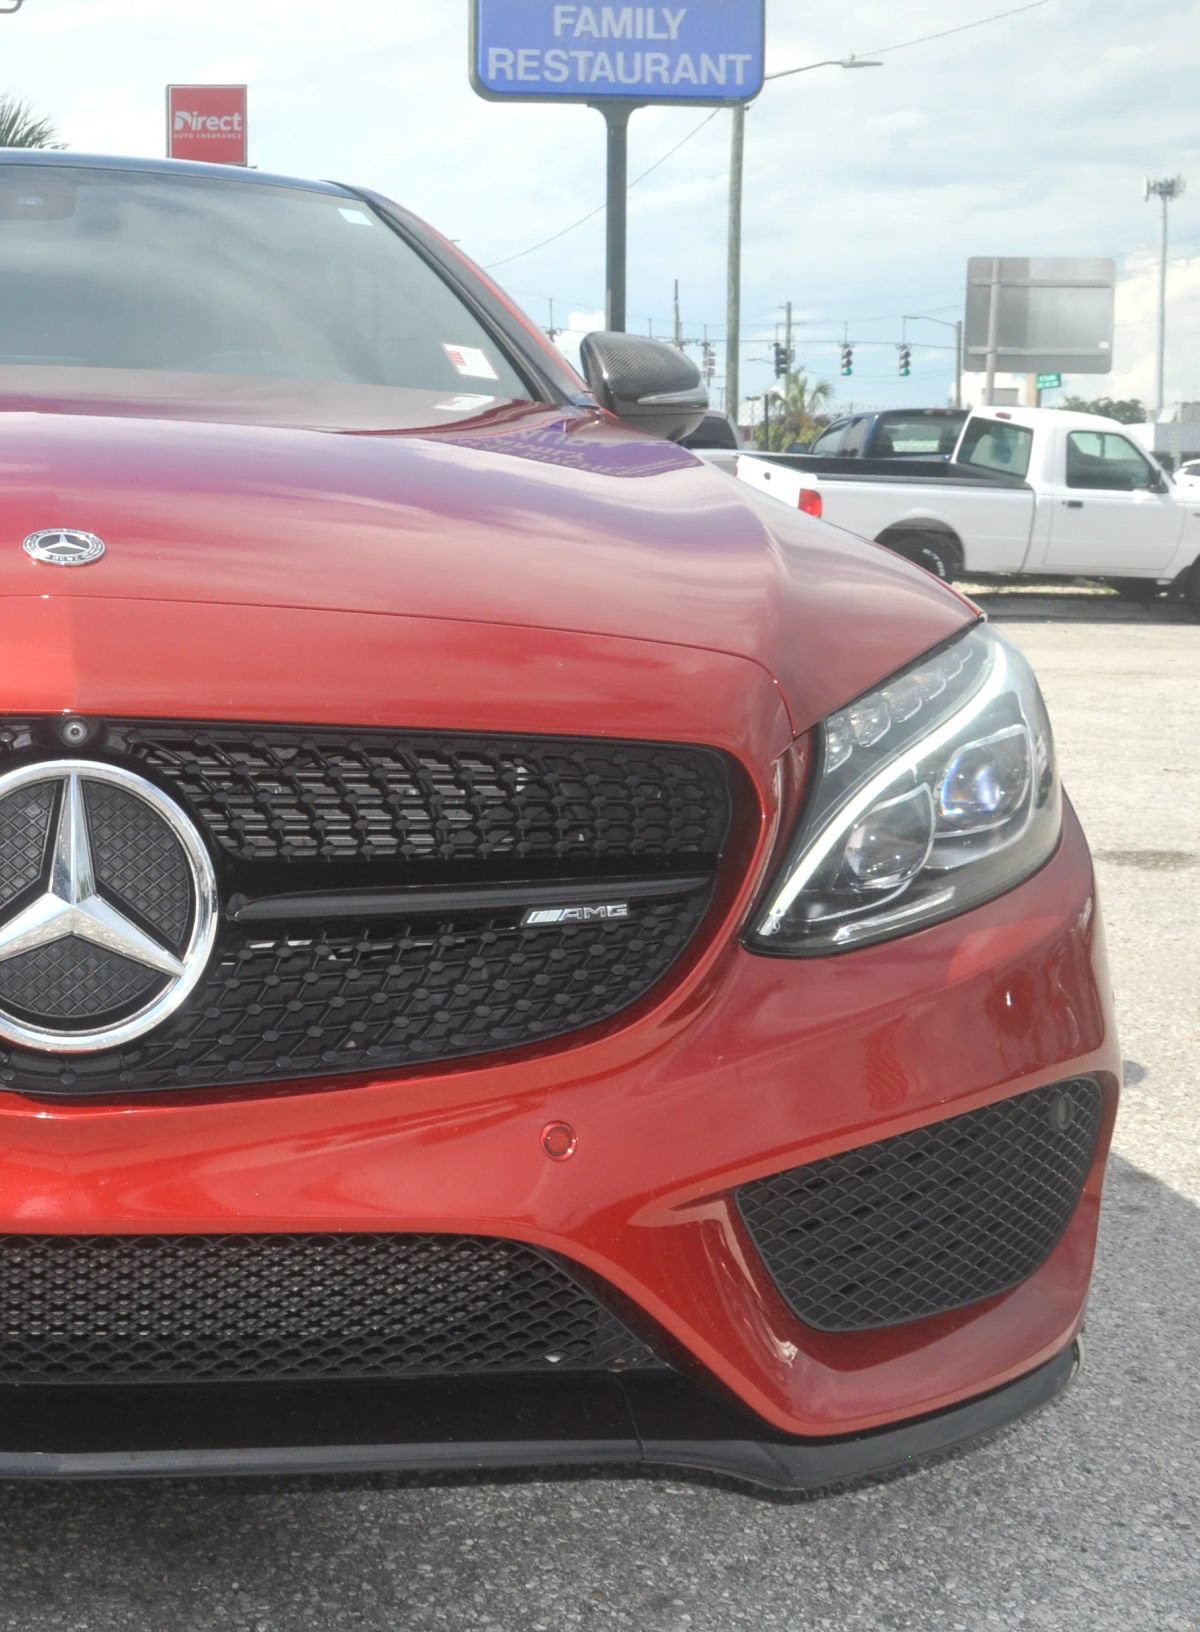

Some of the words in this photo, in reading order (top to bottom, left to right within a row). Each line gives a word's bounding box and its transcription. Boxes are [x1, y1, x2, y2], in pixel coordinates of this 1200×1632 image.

[554, 6, 686, 39] FAMILY
[487, 47, 752, 86] RESTAURANT
[175, 111, 241, 131] Direct
[558, 904, 628, 921] AMG
